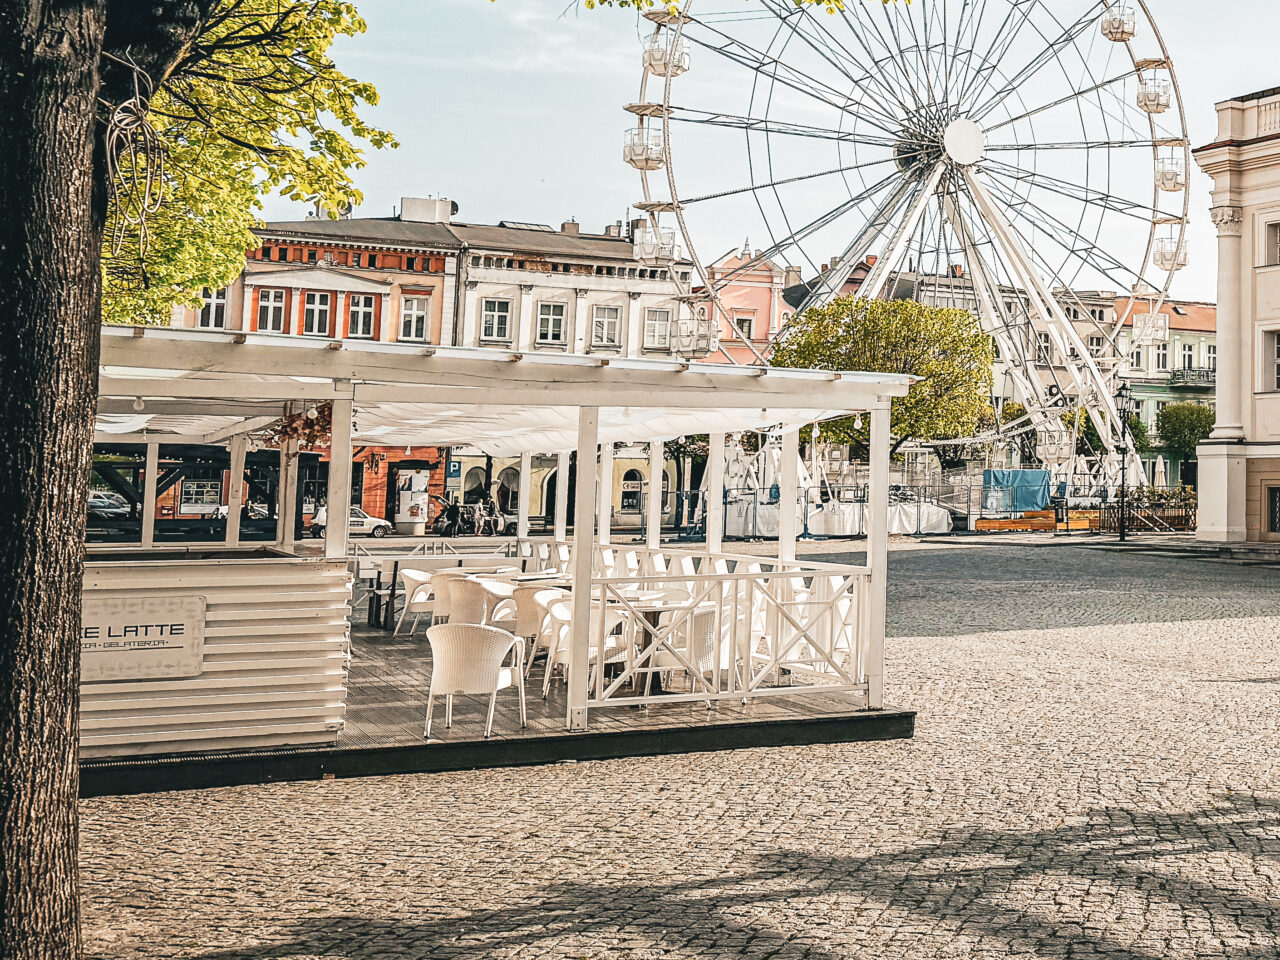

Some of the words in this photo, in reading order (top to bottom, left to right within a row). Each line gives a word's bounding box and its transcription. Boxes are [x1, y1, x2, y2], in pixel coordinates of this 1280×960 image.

[450, 462, 459, 473] P
[108, 624, 184, 637] LATTE
[103, 639, 165, 649] GELATERIA
